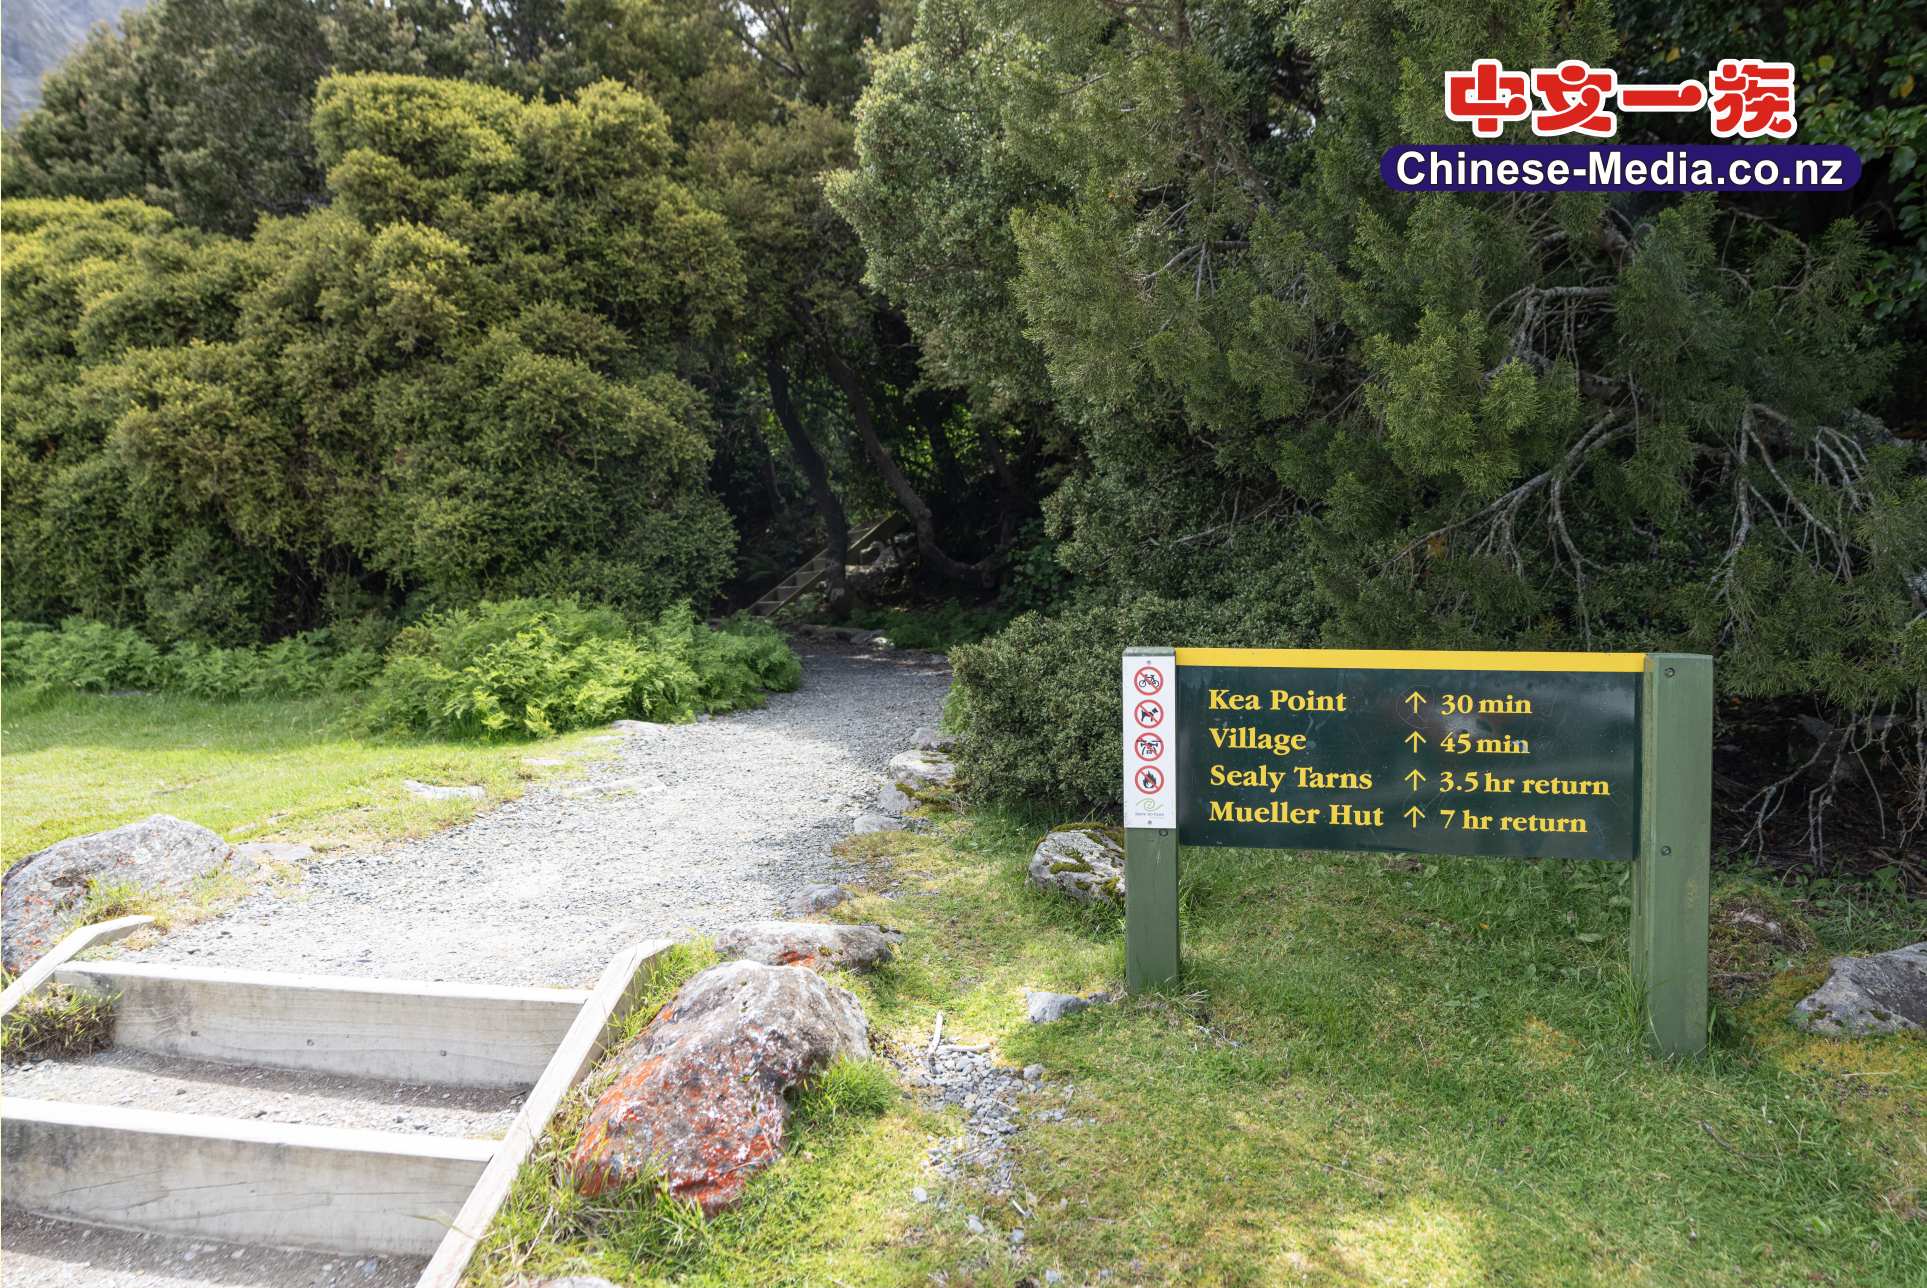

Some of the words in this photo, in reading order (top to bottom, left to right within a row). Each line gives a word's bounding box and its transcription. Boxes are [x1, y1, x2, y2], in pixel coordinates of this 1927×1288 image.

[1208, 689, 1261, 711] Kea
[1270, 690, 1346, 712] Point
[1440, 694, 1474, 716] 30
[1478, 694, 1533, 714] min
[1209, 727, 1307, 756] Village
[1440, 732, 1472, 754] 45
[1476, 735, 1531, 755] min
[1210, 764, 1286, 793] Sealy
[1294, 766, 1373, 790] Tarns
[1440, 771, 1479, 793] 3.5
[1485, 772, 1515, 794] hr
[1522, 778, 1610, 796] return
[1208, 801, 1320, 825] Mueller
[1329, 804, 1384, 828] Hut
[1440, 809, 1455, 830] 7
[1462, 809, 1493, 831] hr
[1500, 815, 1588, 833] return
